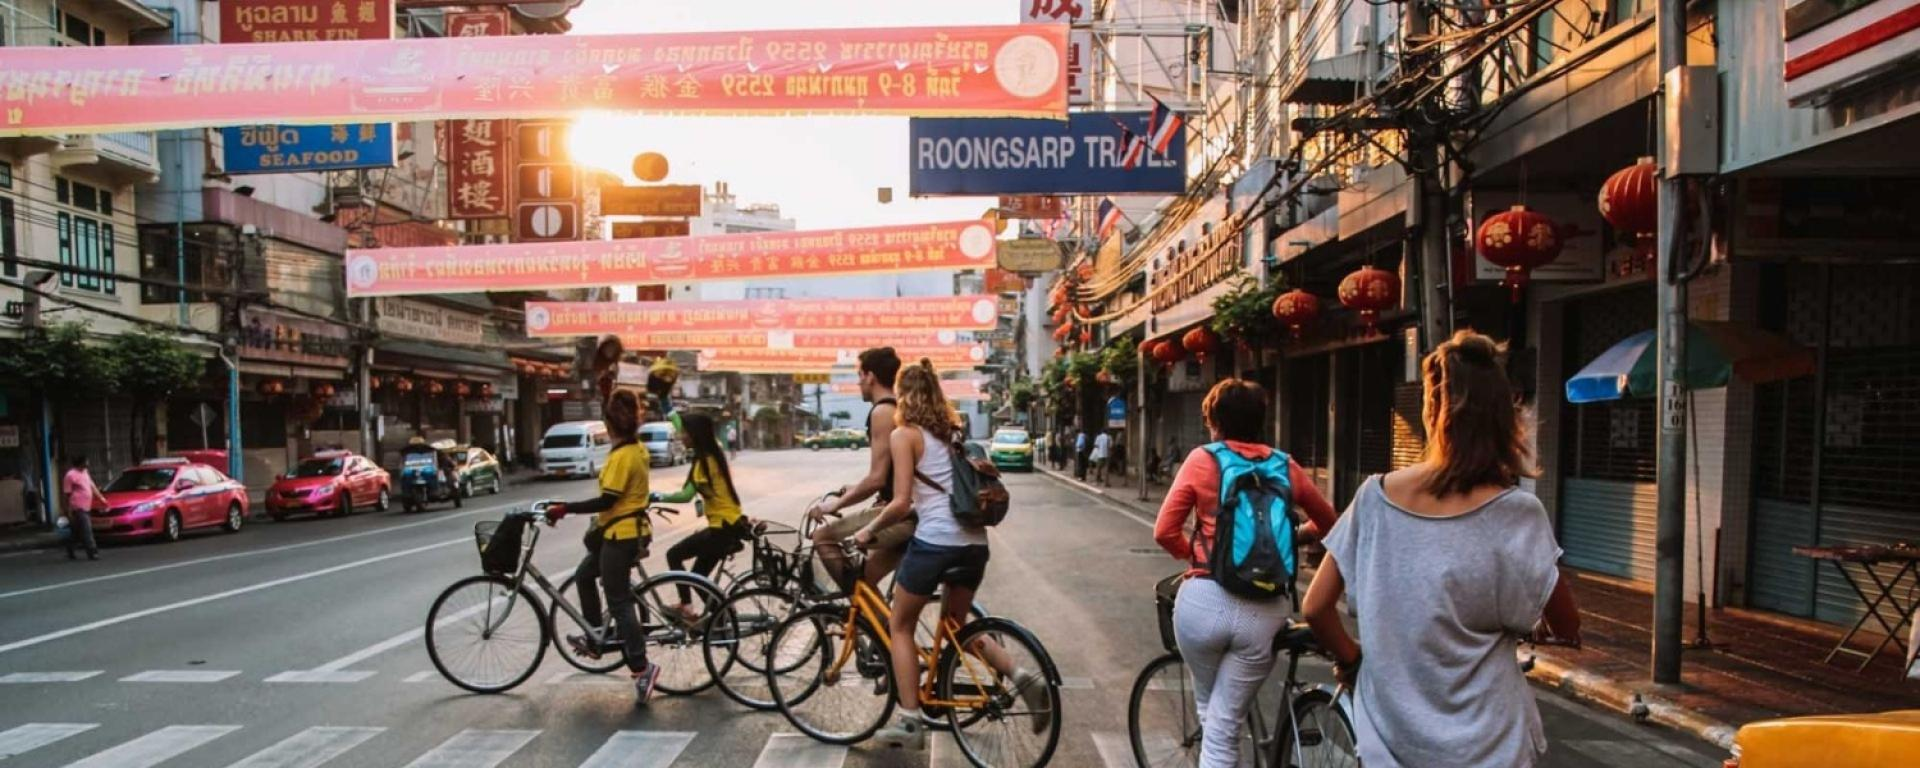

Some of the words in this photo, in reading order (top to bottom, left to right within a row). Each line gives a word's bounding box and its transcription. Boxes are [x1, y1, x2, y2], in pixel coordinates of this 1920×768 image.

[235, 5, 318, 32] หูฉลาม
[252, 29, 319, 42] SHARK
[325, 28, 359, 40] FIN
[259, 149, 359, 168] SEAFOOD
[917, 136, 1075, 170] ROONGSARP
